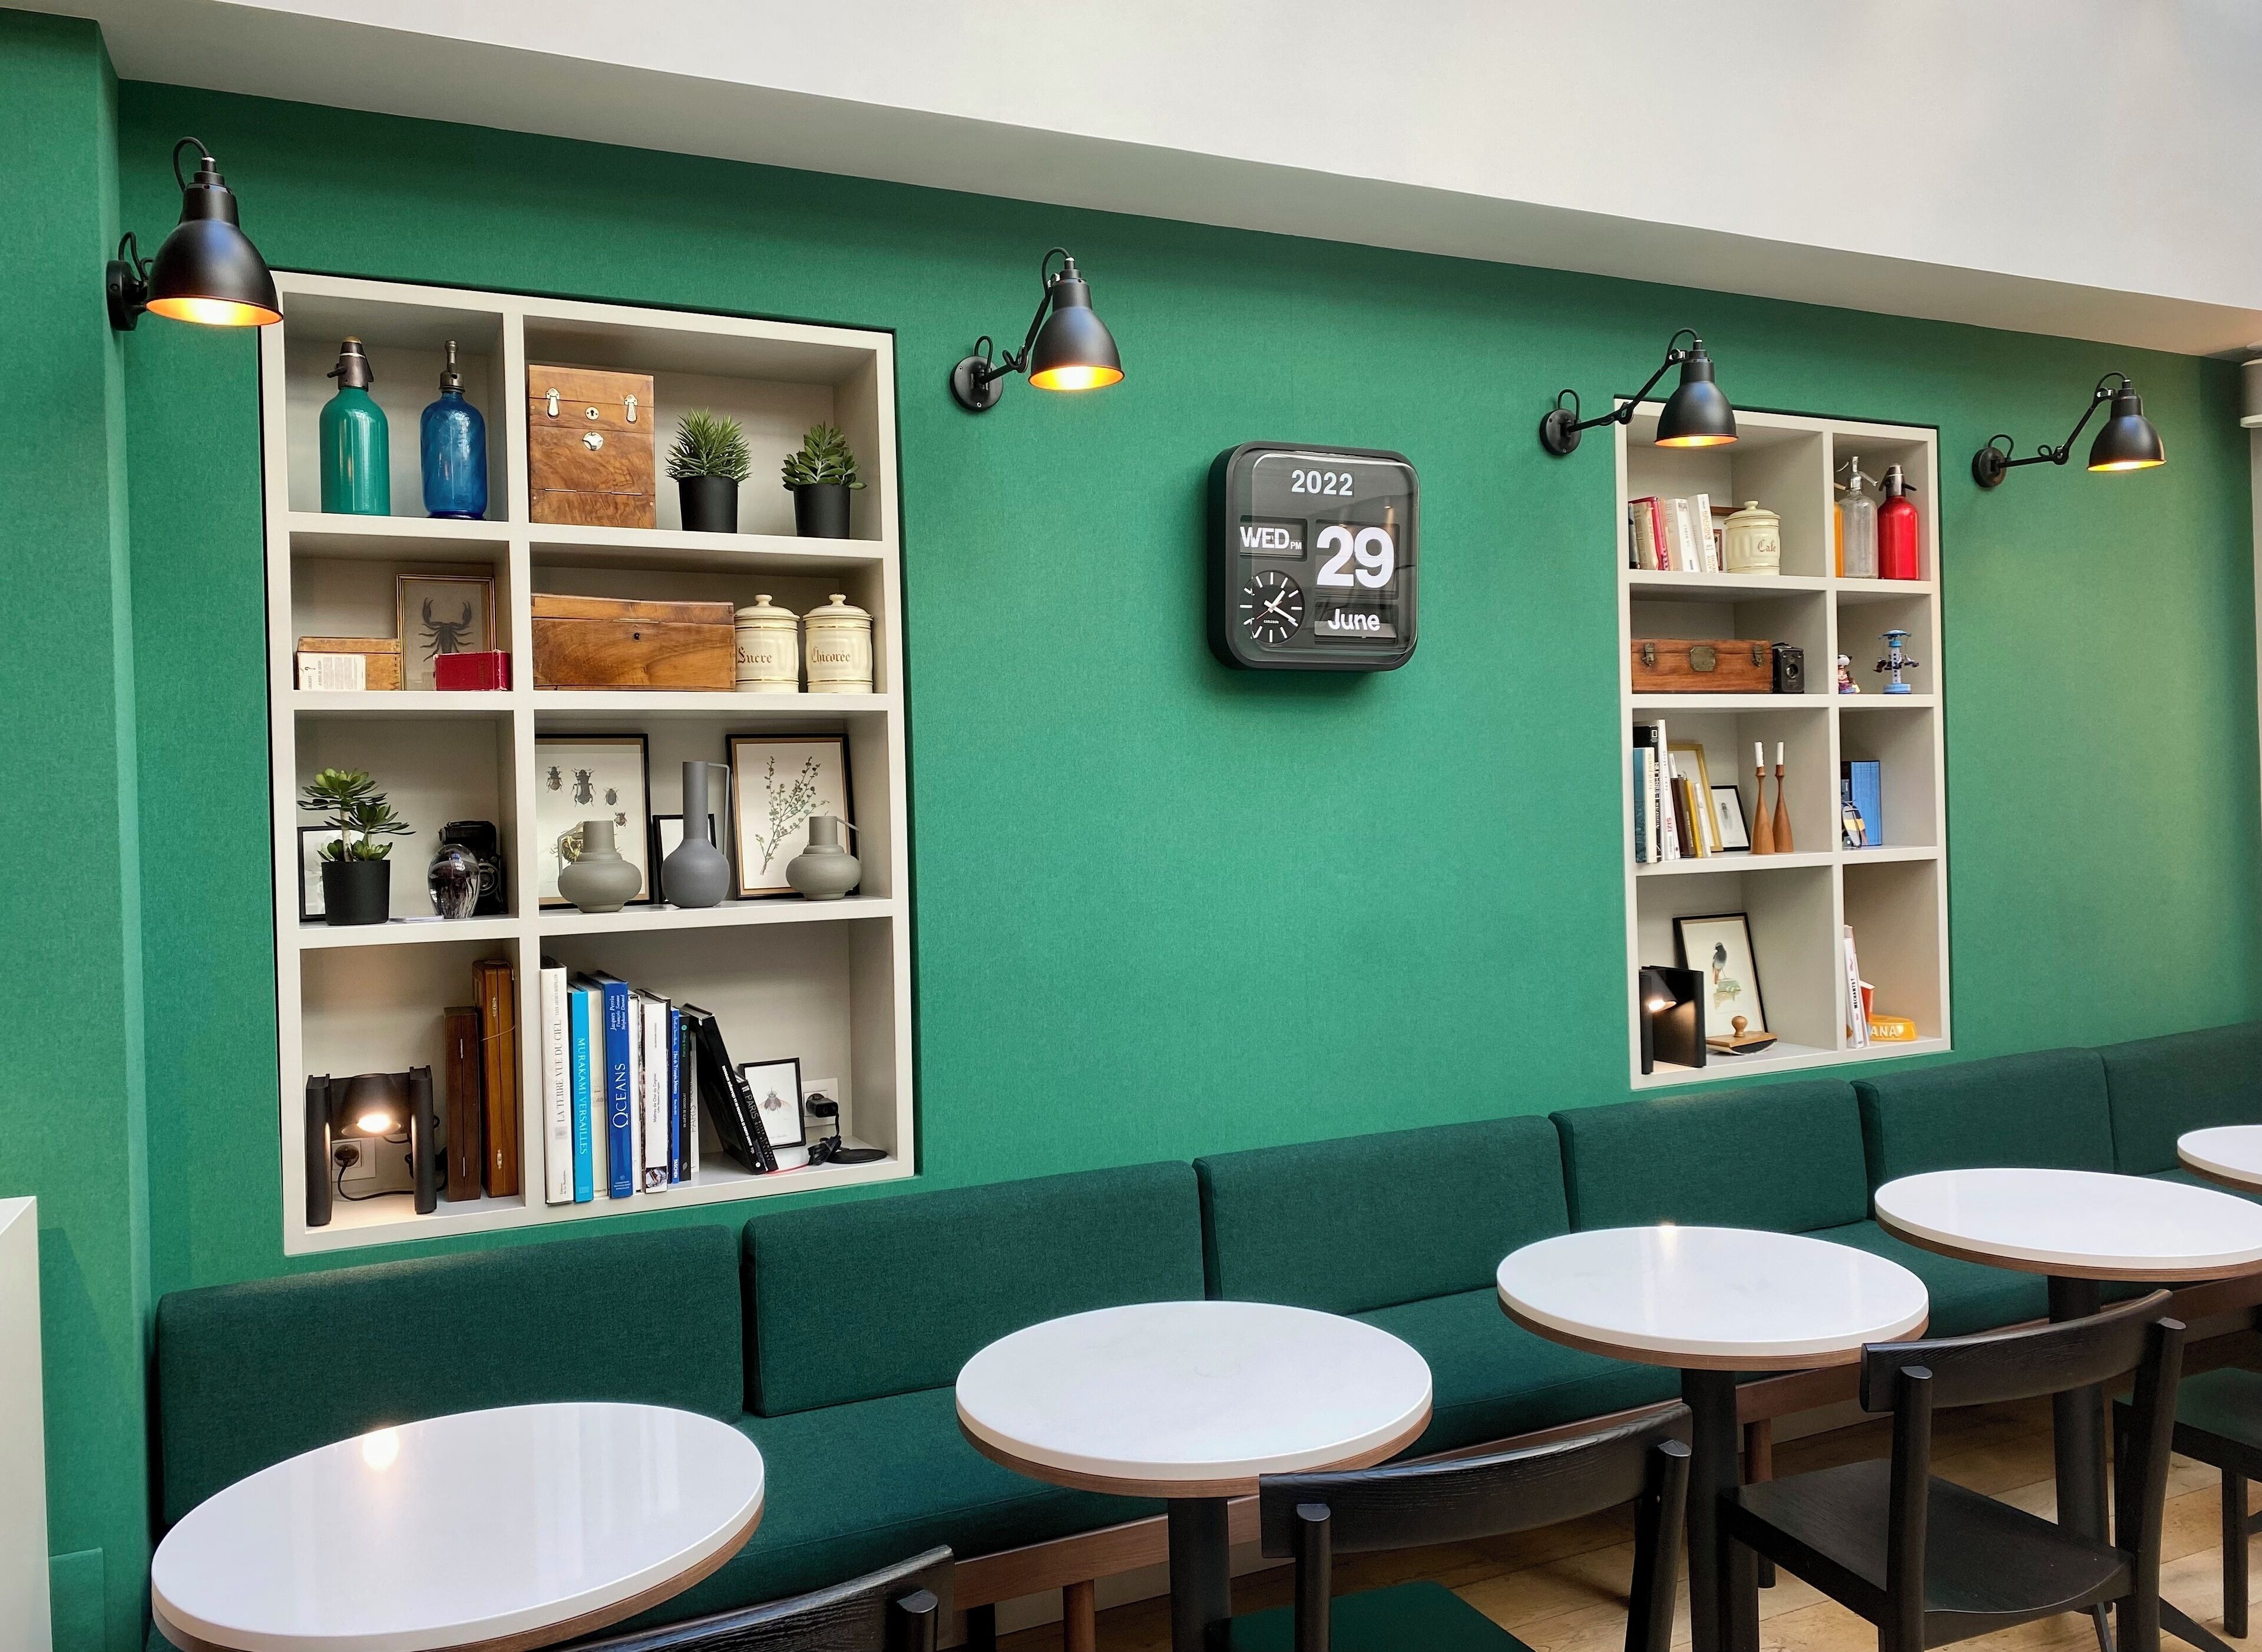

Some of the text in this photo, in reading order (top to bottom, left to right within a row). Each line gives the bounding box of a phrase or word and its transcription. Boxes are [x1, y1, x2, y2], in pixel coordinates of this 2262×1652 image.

[1291, 470, 1352, 496] 2022
[1239, 526, 1302, 550] WED PM
[1316, 525, 1395, 588] 29
[1327, 608, 1380, 631] June
[738, 647, 772, 664] Sucre
[554, 1019, 566, 1123] LA TERRE VUE DU CIEL
[578, 1038, 588, 1155] MURAKAMI VERSAILLES
[745, 1094, 759, 1119] PARIS
